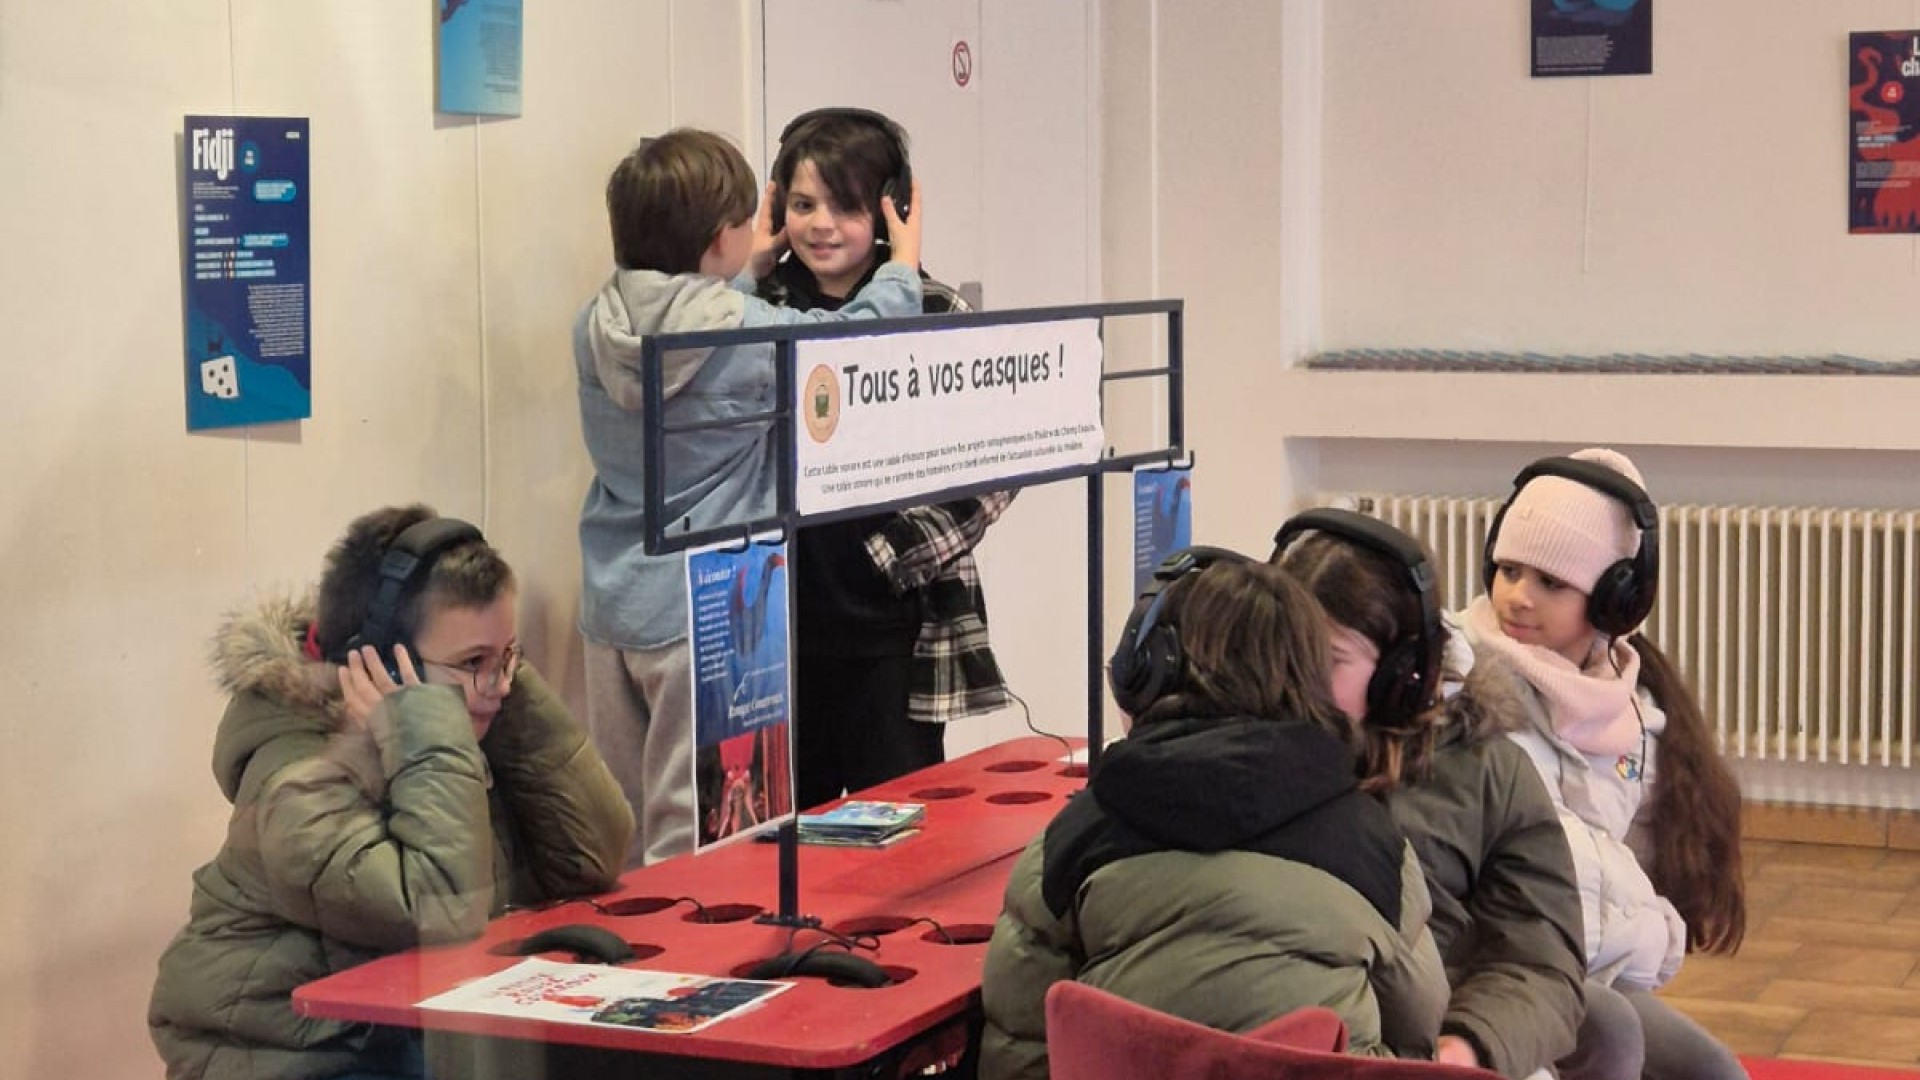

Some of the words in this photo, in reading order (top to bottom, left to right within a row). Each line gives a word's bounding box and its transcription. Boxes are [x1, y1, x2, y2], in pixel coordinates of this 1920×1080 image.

[193, 128, 234, 181] Fidji
[843, 364, 899, 407] Tous
[907, 353, 920, 398] à
[928, 361, 964, 396] vos
[971, 351, 1049, 395] casques
[1058, 342, 1064, 378] !
